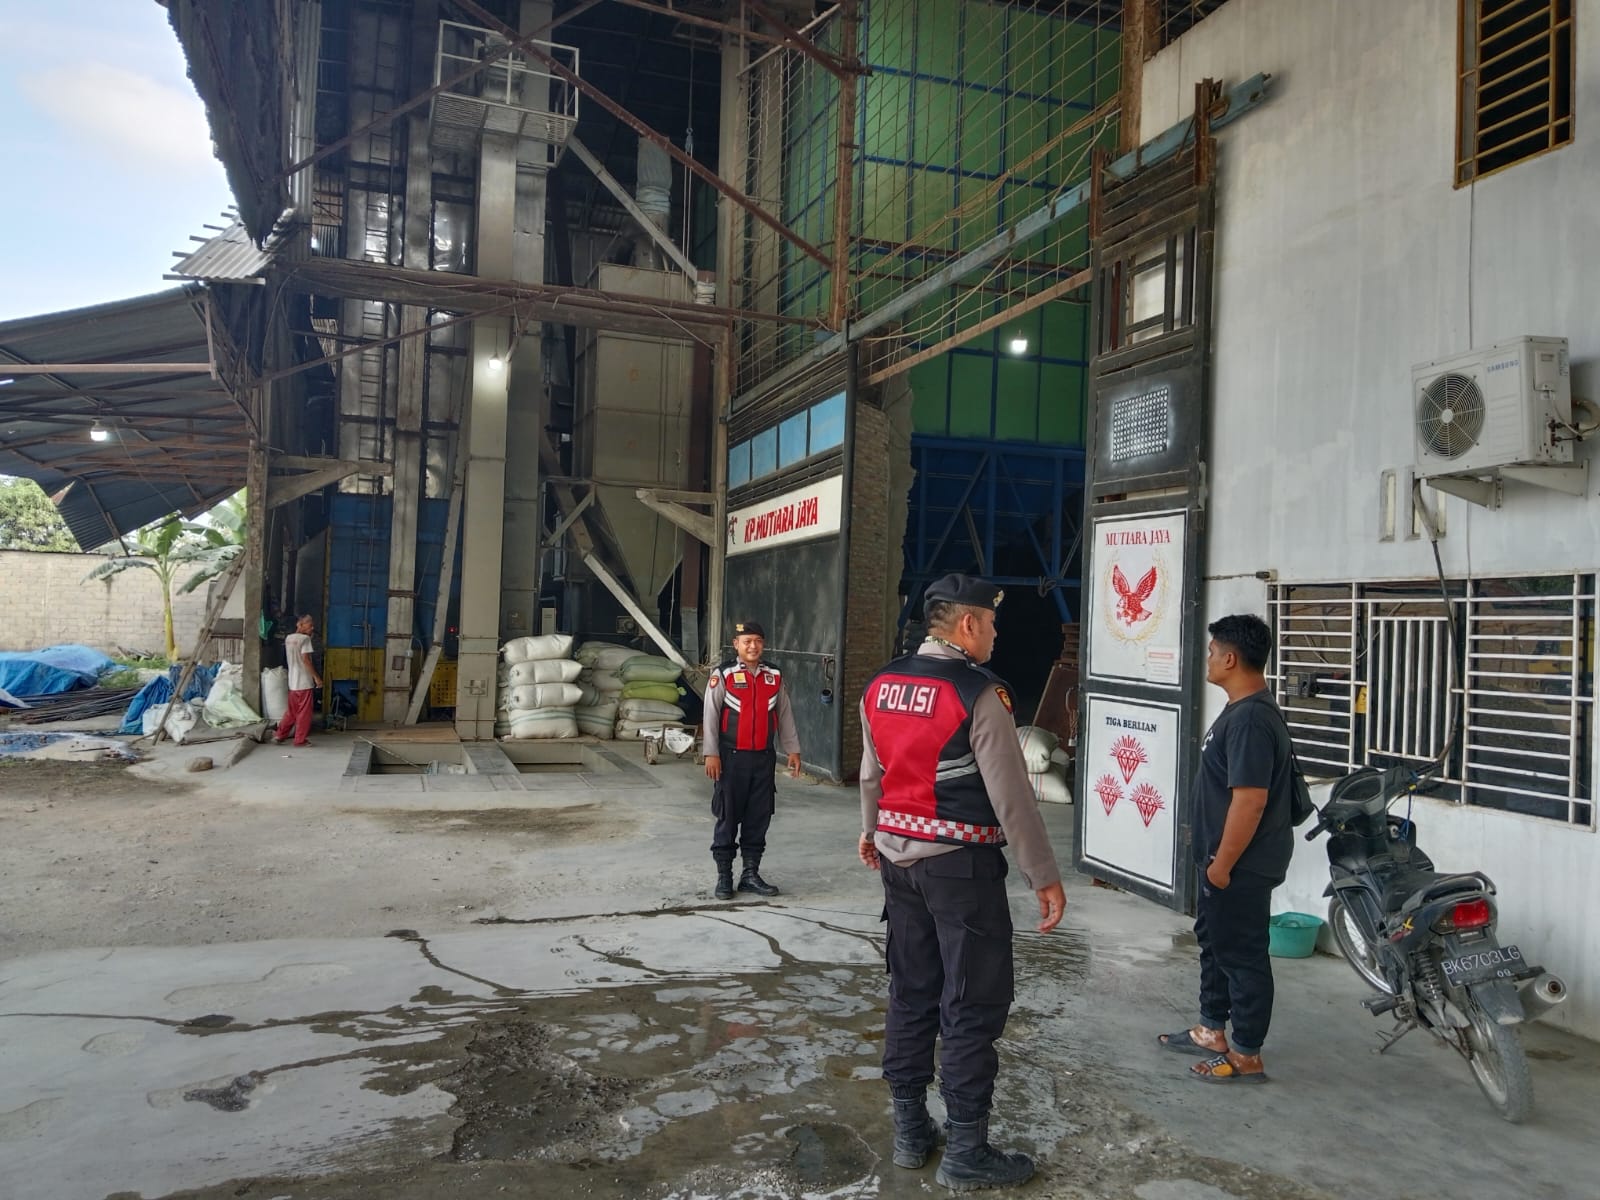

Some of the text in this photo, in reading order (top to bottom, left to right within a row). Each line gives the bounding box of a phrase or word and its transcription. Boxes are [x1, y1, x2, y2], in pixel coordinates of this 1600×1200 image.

[1487, 360, 1520, 373] SAMSUNG
[1106, 529, 1171, 546] MUTIARA JAYA
[876, 683, 936, 714] POLISI
[1105, 717, 1157, 733] TIGA BERLIAN
